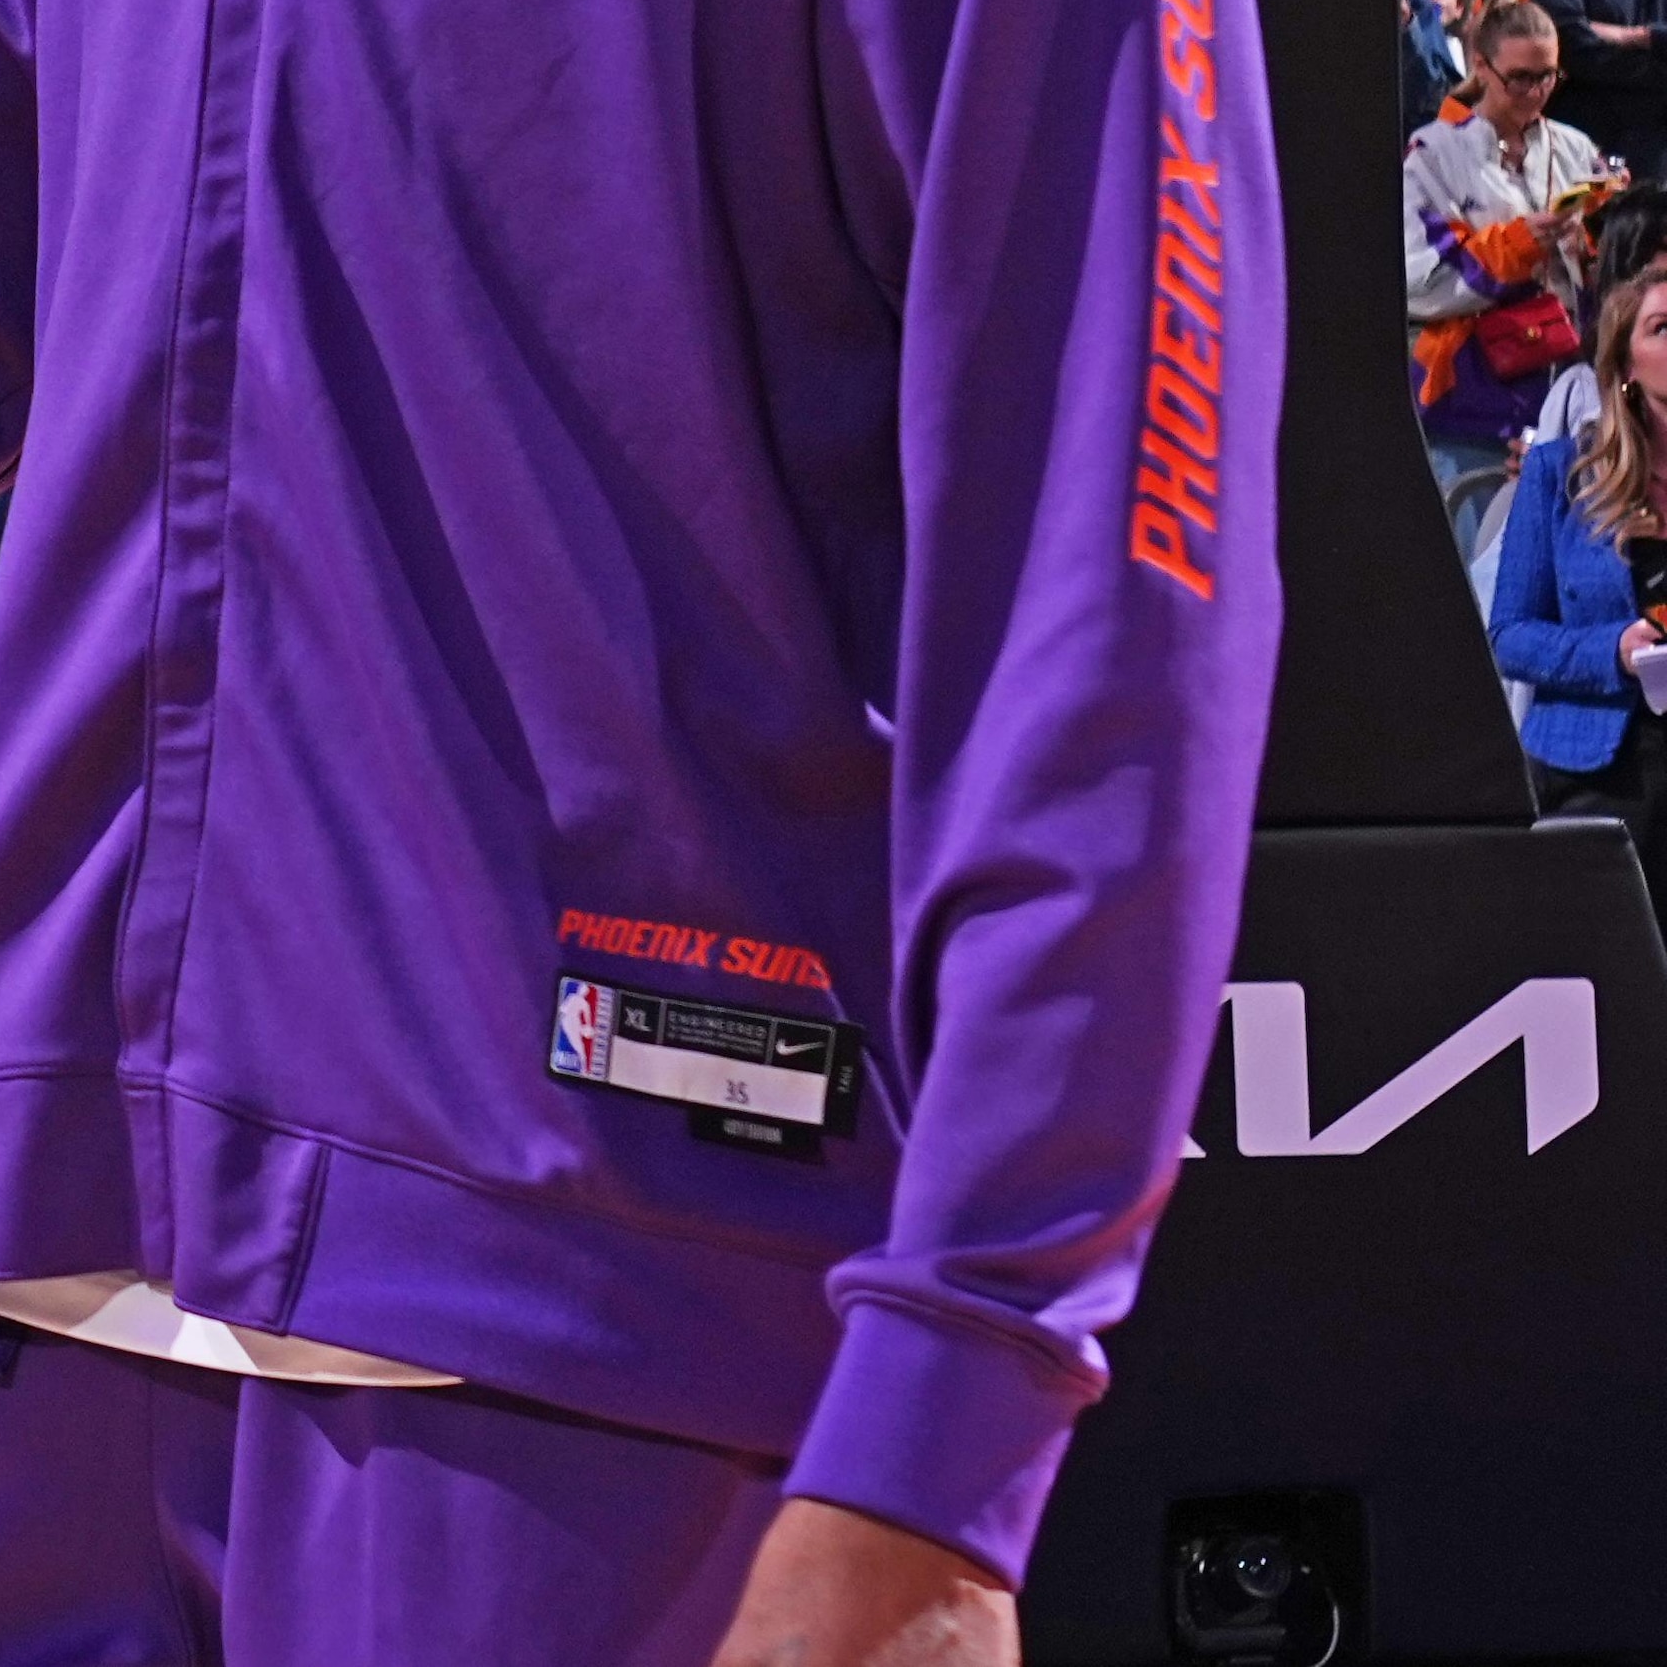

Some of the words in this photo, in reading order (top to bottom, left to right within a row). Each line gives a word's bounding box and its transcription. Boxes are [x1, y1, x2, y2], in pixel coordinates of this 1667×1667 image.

[1128, 119, 1227, 600] PHOENIX
[556, 907, 722, 968] PHOENIX
[624, 1006, 651, 1033] XL
[1181, 977, 1600, 1158] IA
